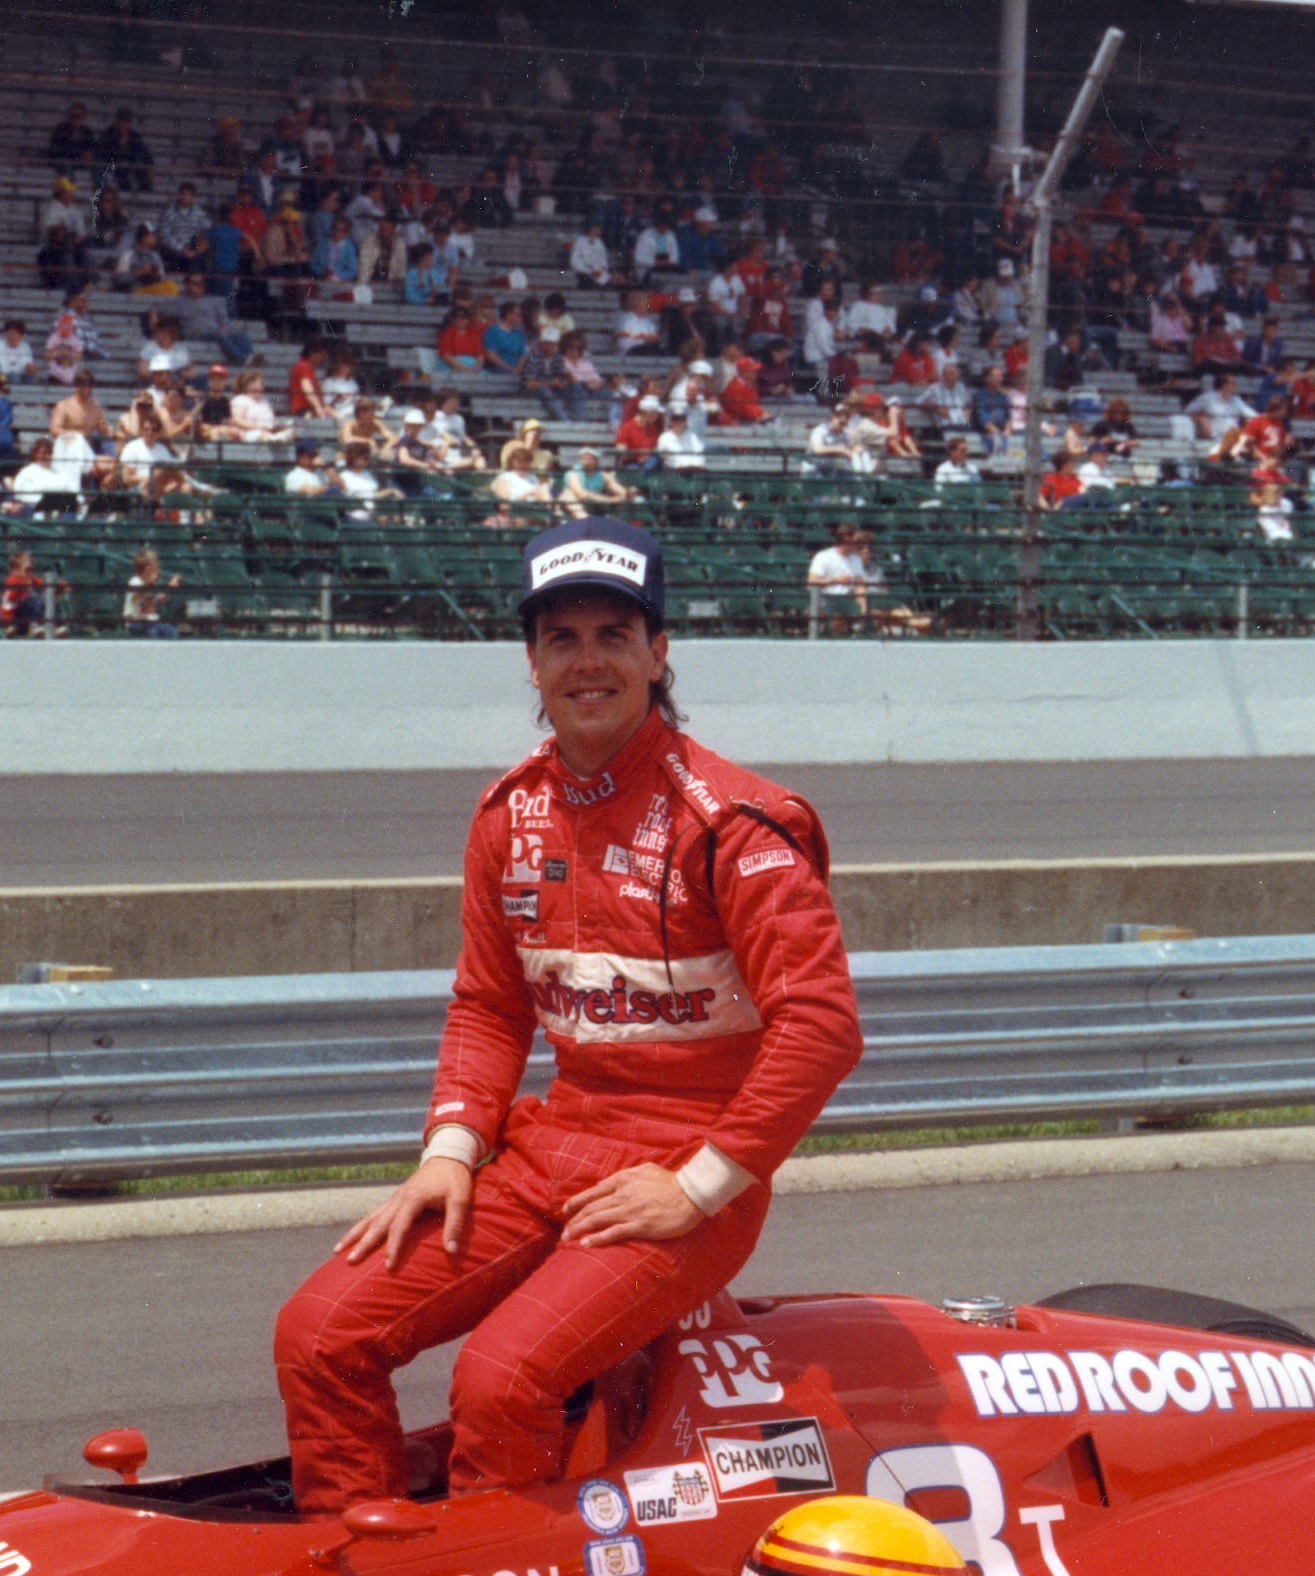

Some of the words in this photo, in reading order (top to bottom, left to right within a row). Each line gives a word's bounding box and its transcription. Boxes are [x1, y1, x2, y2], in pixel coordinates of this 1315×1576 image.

[539, 547, 639, 576] GOODYEAR
[563, 770, 617, 806] Bud
[665, 752, 721, 815] GOODYEAR
[741, 850, 791, 871] SIMPSON
[715, 1442, 822, 1475] CHAMPION
[636, 1498, 677, 1523] USAC
